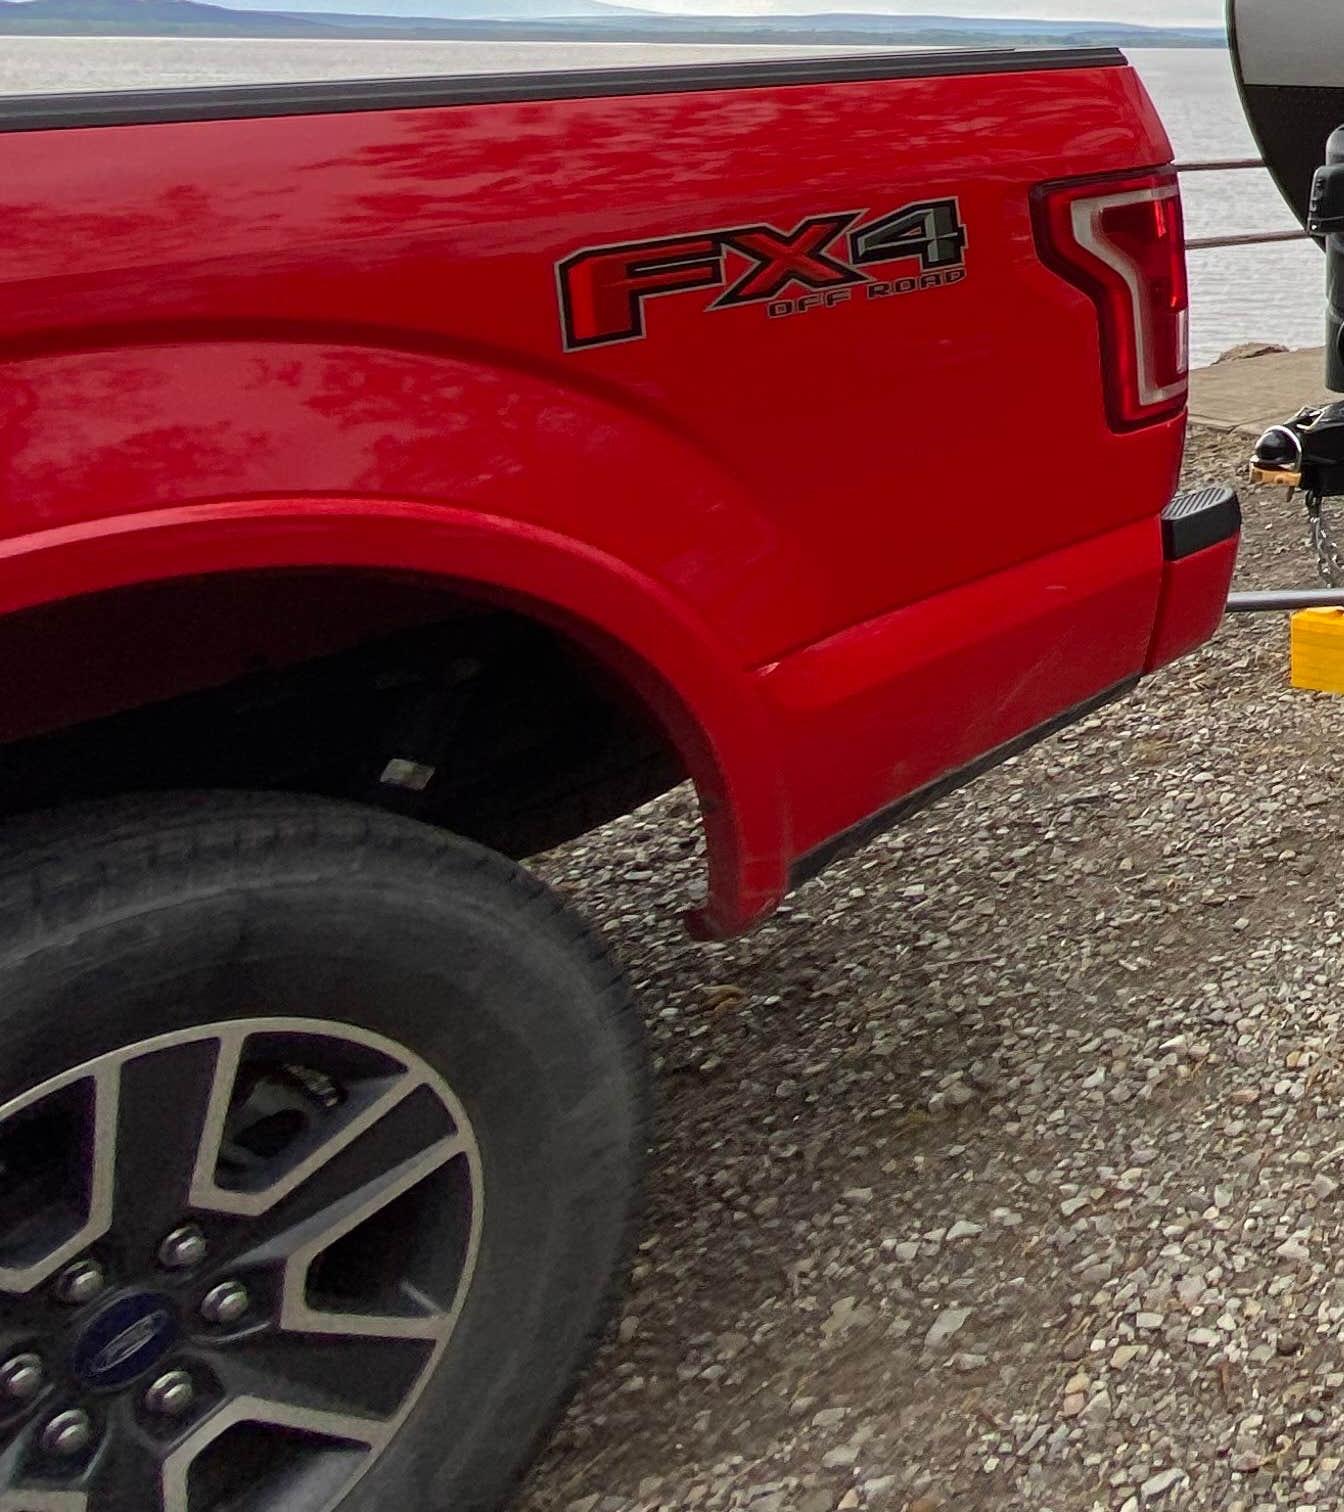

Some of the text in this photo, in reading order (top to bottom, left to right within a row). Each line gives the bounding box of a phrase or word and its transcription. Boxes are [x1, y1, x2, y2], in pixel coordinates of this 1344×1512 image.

[553, 196, 967, 353] FX4
[766, 268, 967, 320] OFF ROAD
